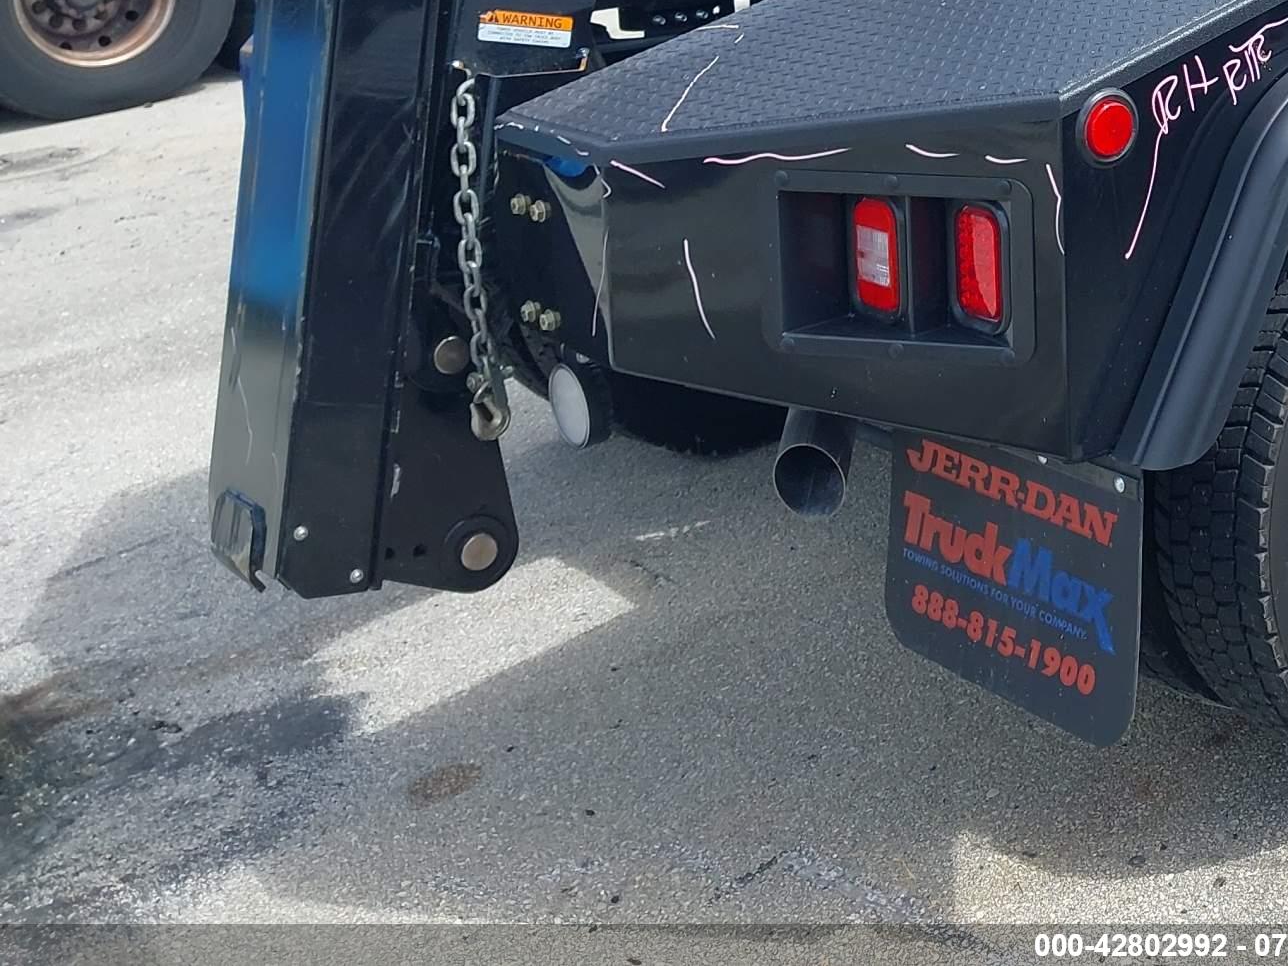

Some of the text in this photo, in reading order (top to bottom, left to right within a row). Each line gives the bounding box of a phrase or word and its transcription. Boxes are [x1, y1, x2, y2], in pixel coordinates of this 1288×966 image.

[502, 13, 562, 29] WARNING
[906, 439, 1118, 546] JERR-DAN
[903, 548, 938, 572] TOWING
[940, 564, 989, 596] SOLUTIONS
[991, 587, 1009, 606] FOR
[1010, 596, 1037, 618] YOUR
[912, 585, 1096, 696] 888-815-1900
